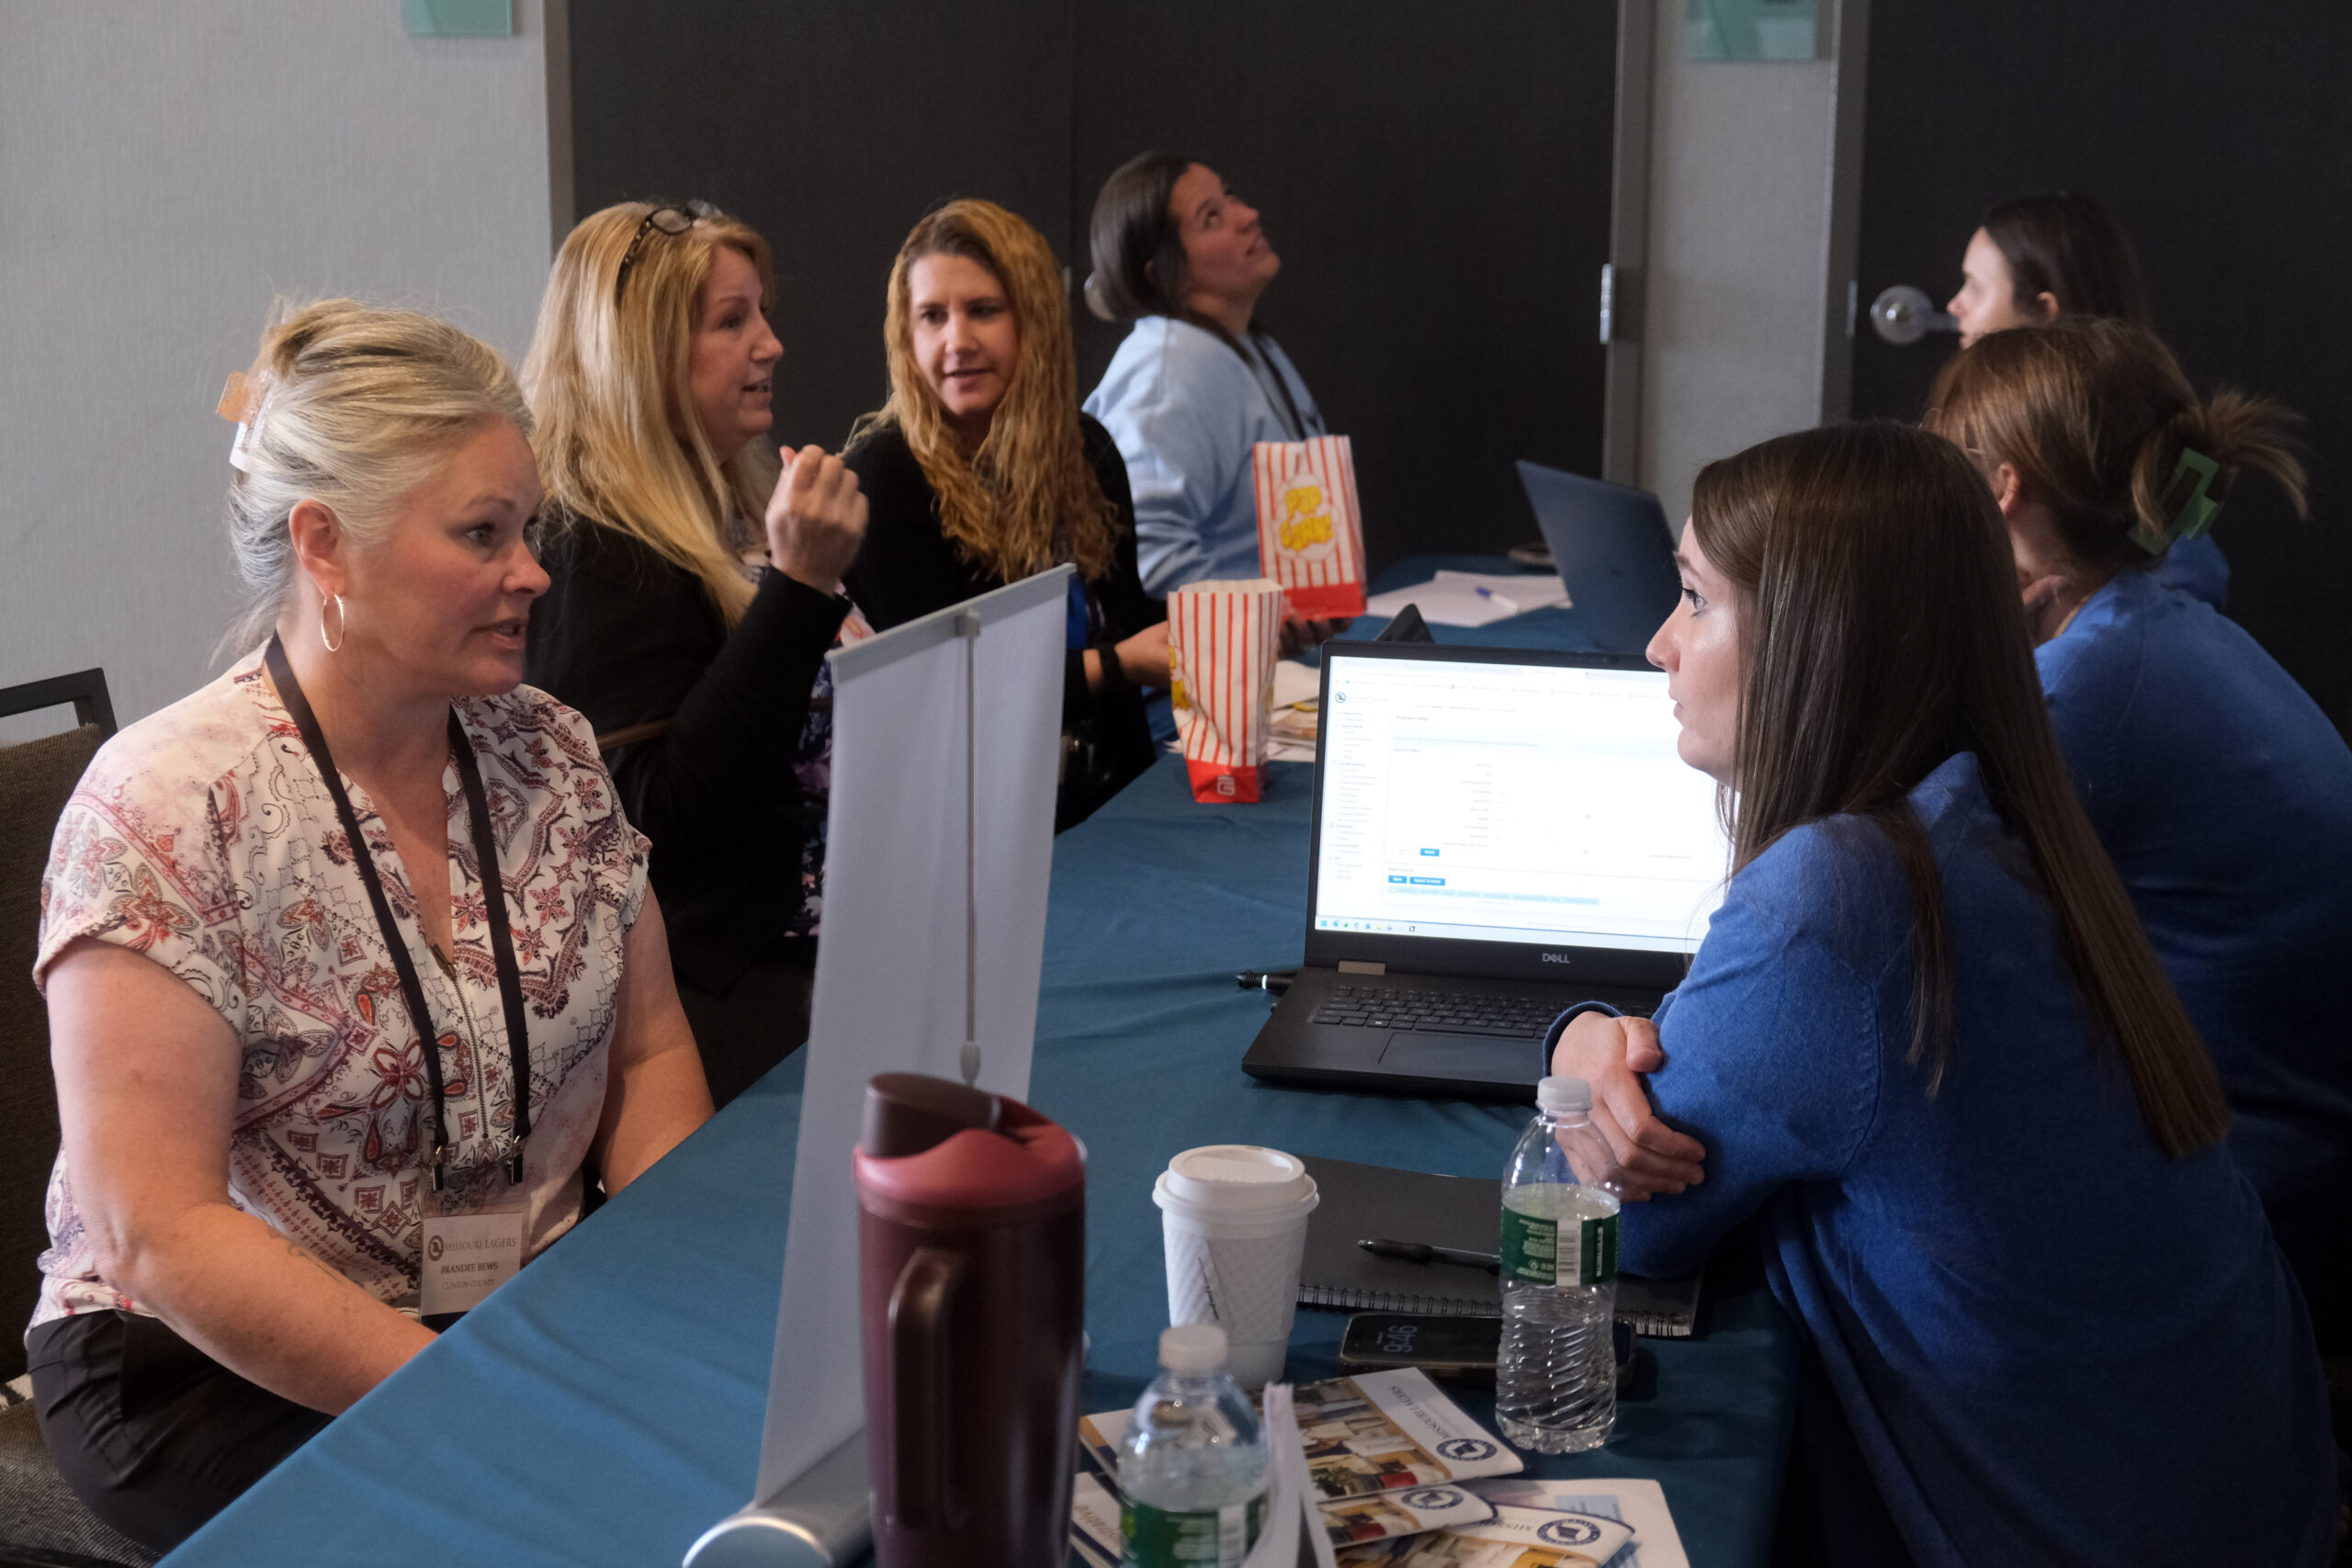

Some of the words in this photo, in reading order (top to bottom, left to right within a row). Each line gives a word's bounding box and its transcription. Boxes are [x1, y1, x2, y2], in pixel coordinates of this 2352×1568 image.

[1543, 953, 1570, 964] DELL
[446, 1240, 482, 1251] MISSOURI
[484, 1237, 516, 1249] LAGERS
[441, 1263, 476, 1274] BRANDEE
[1383, 1325, 1418, 1352] 9:46
